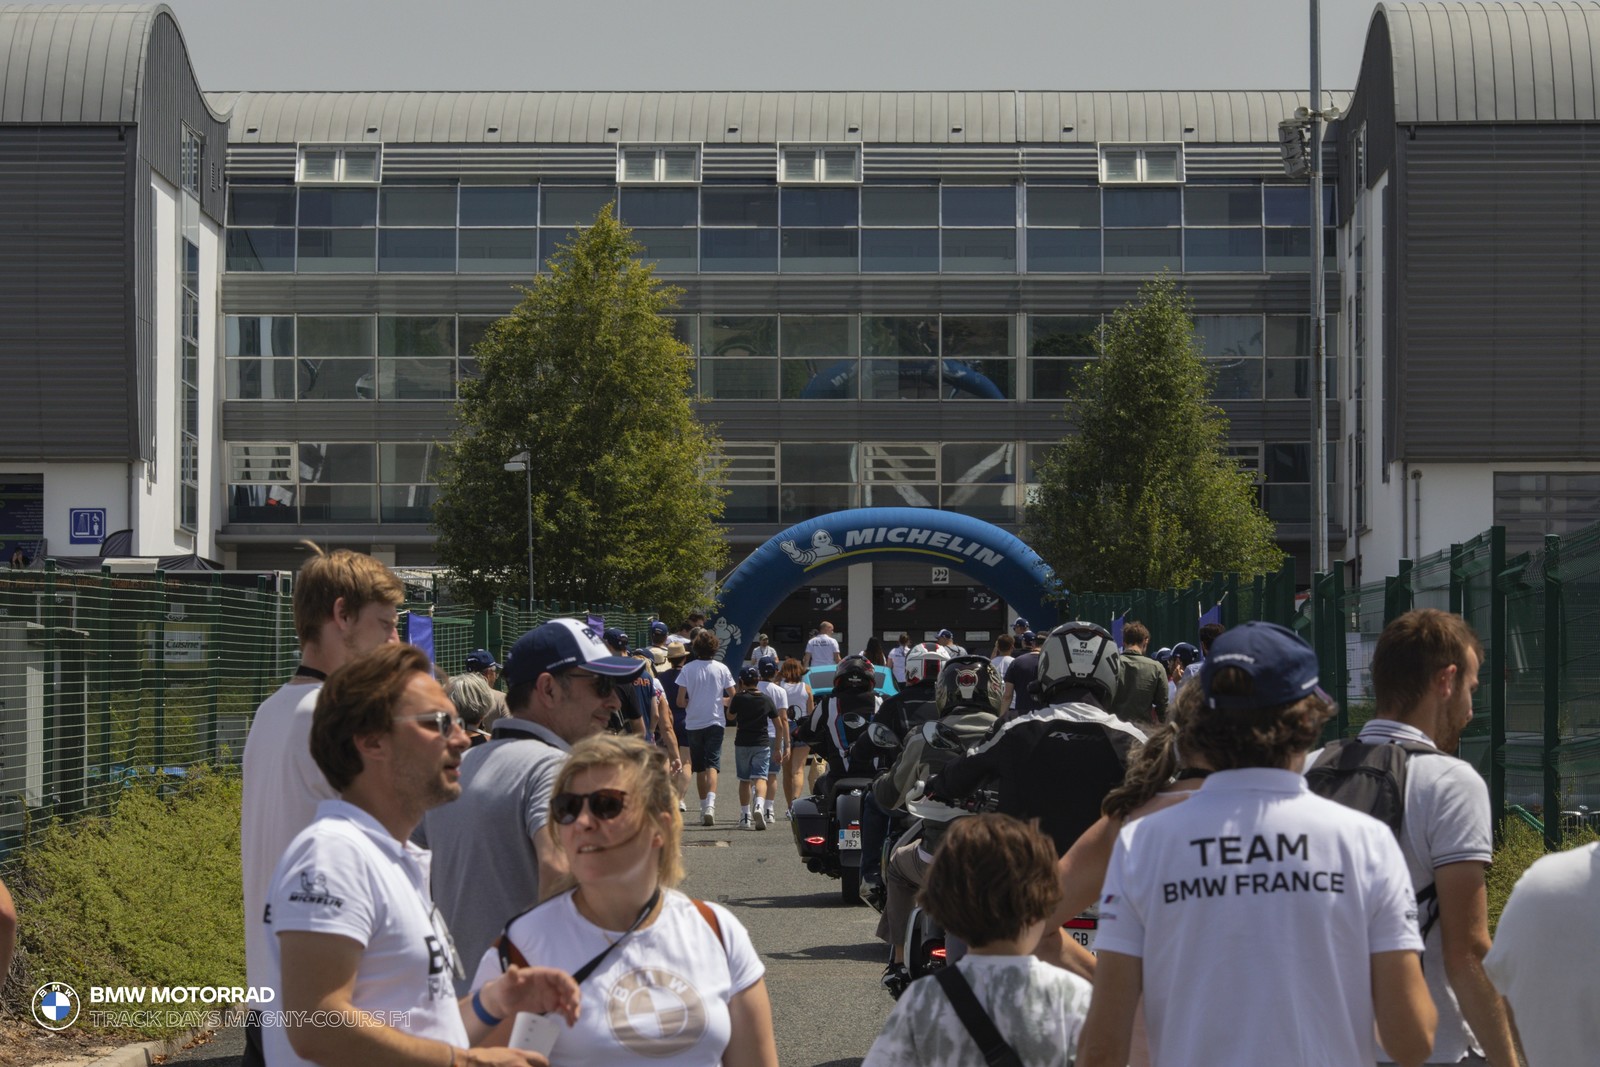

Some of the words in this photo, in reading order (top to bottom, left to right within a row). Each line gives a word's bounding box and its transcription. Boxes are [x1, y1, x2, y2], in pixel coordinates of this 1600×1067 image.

[845, 527, 1005, 567] MICHELIN
[933, 568, 948, 582] 22
[1190, 832, 1309, 867] TEAM
[288, 893, 344, 908] MICHELIN
[1163, 875, 1227, 904] BMW
[1235, 871, 1345, 895] FRANCE
